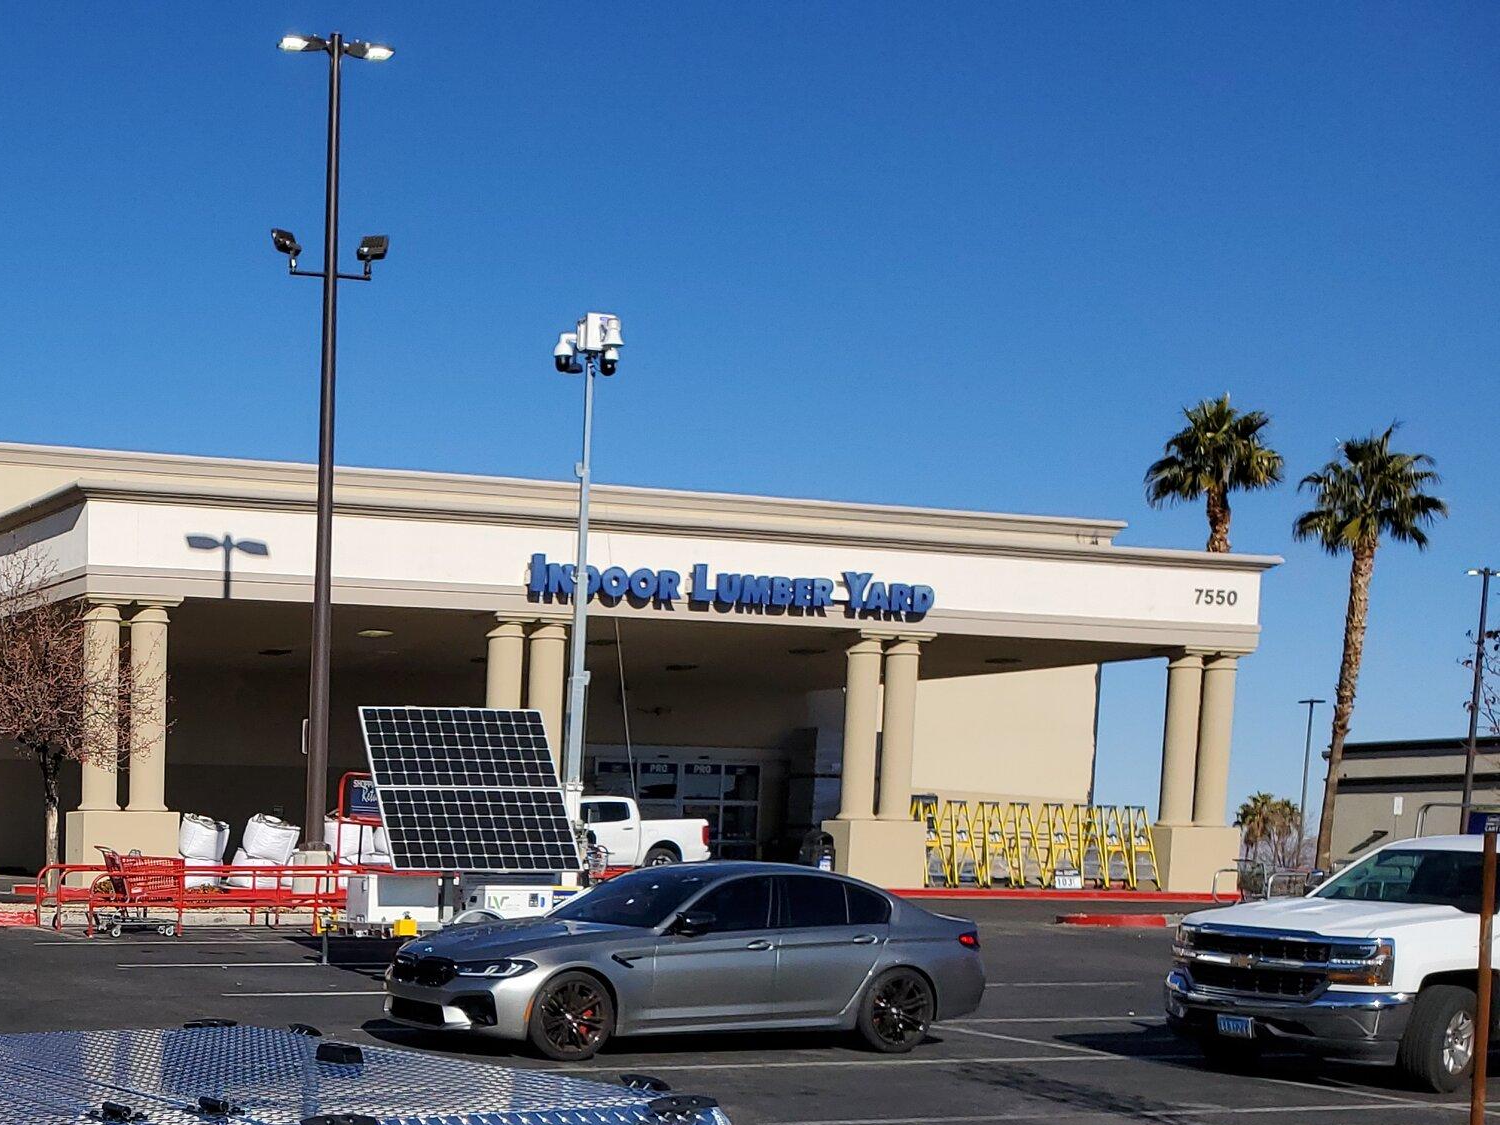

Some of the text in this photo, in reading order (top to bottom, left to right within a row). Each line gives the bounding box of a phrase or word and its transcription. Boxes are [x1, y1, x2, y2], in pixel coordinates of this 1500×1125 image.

[692, 563, 834, 607] LUMBER
[841, 571, 935, 613] YARD
[1194, 588, 1238, 606] 7550
[650, 764, 668, 773] PRO
[693, 765, 711, 774] PRO
